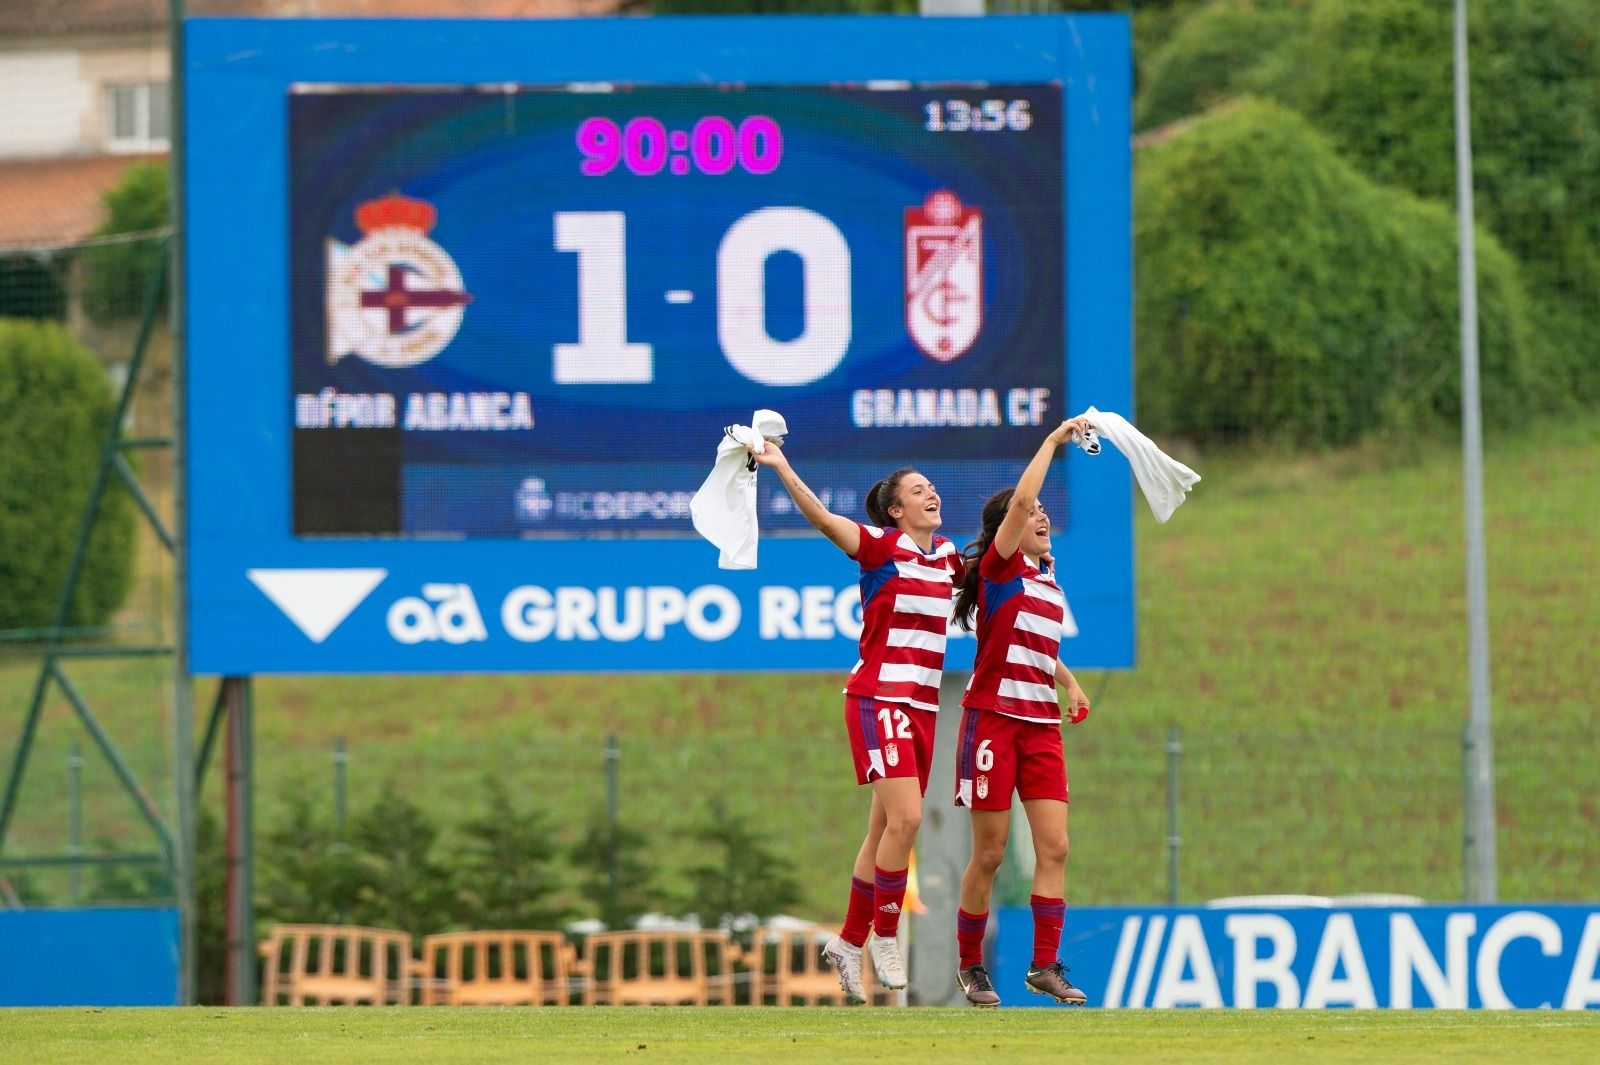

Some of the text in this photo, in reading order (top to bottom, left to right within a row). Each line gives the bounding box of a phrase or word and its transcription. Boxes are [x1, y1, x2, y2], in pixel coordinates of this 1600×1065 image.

[925, 100, 1033, 132] 13:56
[576, 116, 782, 175] 90:00
[552, 211, 653, 385] 1
[716, 206, 852, 386] 0
[852, 388, 1050, 427] GRANADA CF
[502, 585, 741, 642] GRUPO
[878, 708, 912, 739] 12
[976, 739, 994, 771] 6
